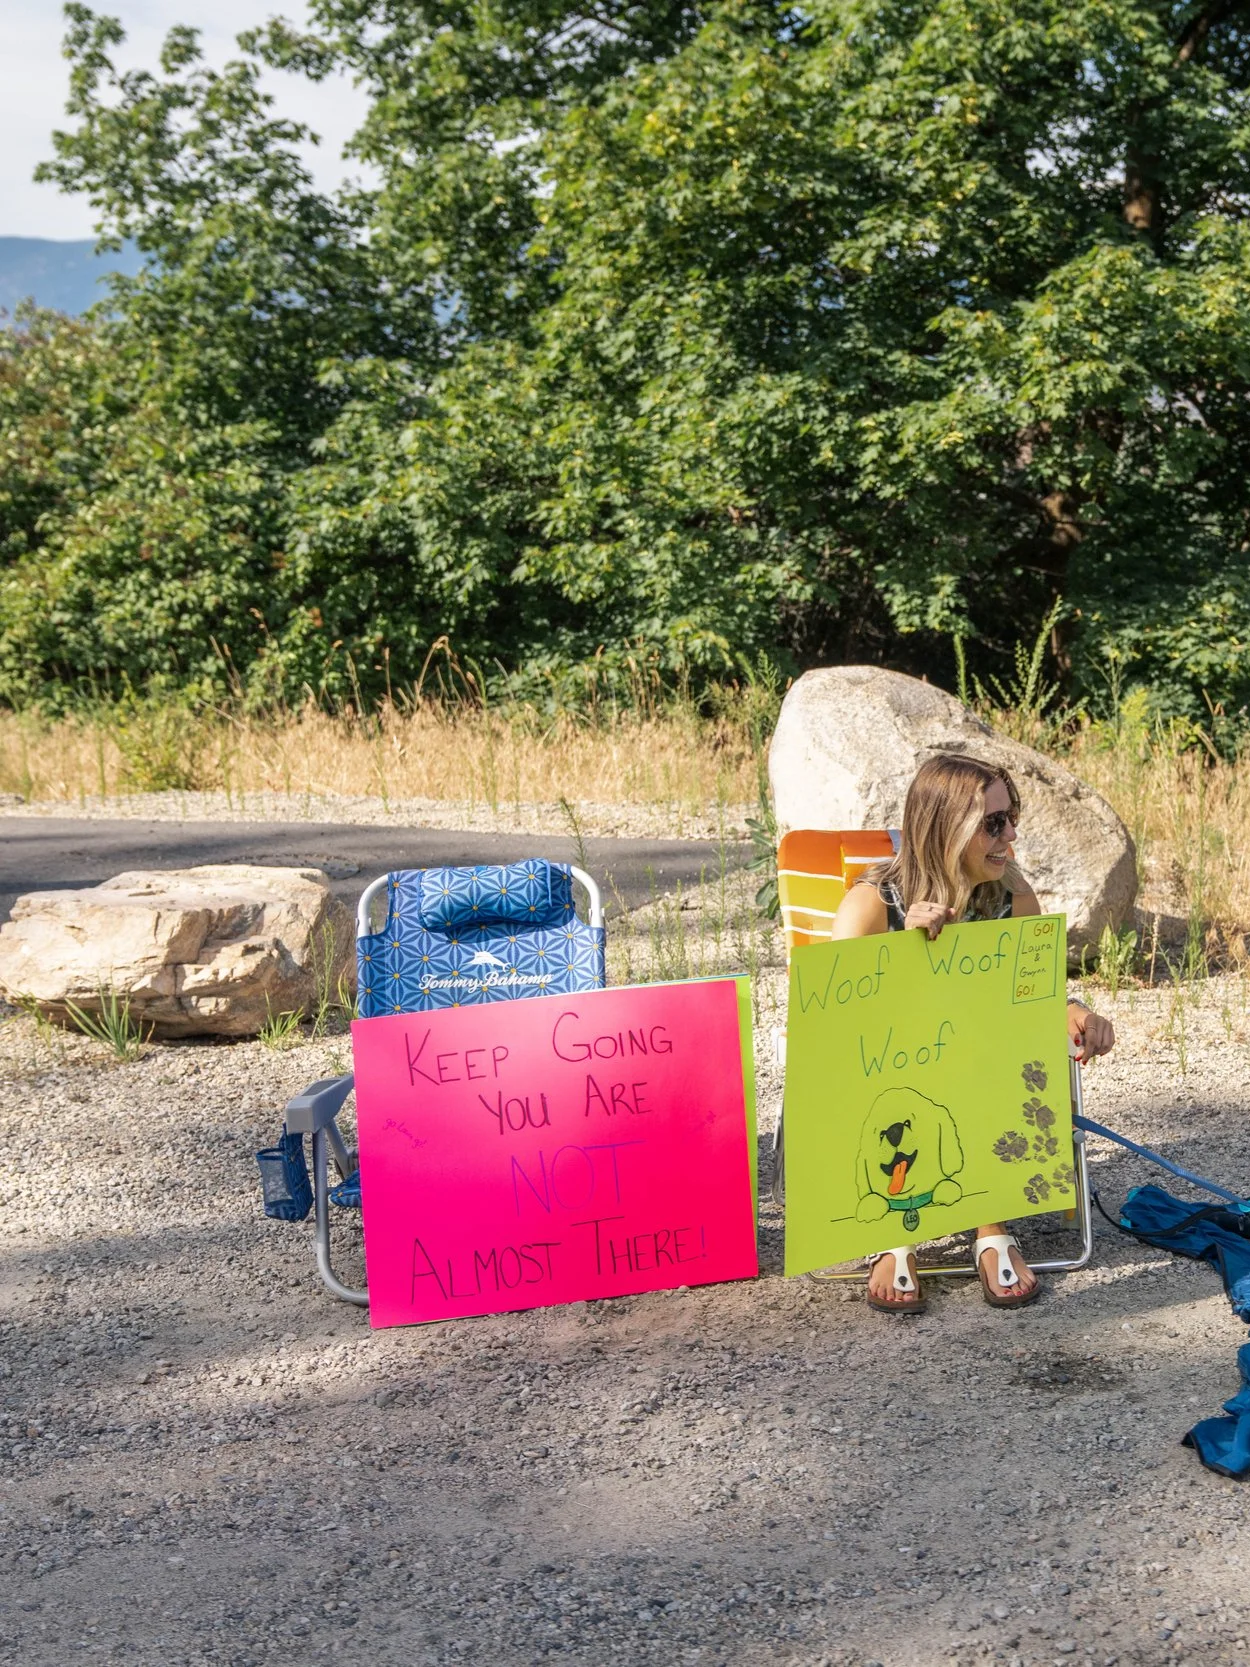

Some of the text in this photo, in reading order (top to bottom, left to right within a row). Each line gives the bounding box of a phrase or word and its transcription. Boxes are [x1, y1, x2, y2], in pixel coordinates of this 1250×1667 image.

[1021, 940, 1053, 954] Laura
[1033, 922, 1054, 936] GO!
[1034, 953, 1040, 962] &
[418, 970, 553, 993] Tommy Bahama
[797, 931, 1011, 1013] Woof Woof
[1016, 984, 1035, 997] GO!
[404, 1011, 673, 1086] KEEP GOING
[860, 1020, 955, 1077] Woof
[478, 1074, 652, 1135] YOU ARE
[511, 1140, 646, 1217] NOT
[411, 1216, 708, 1305] ALMOST THERE!
